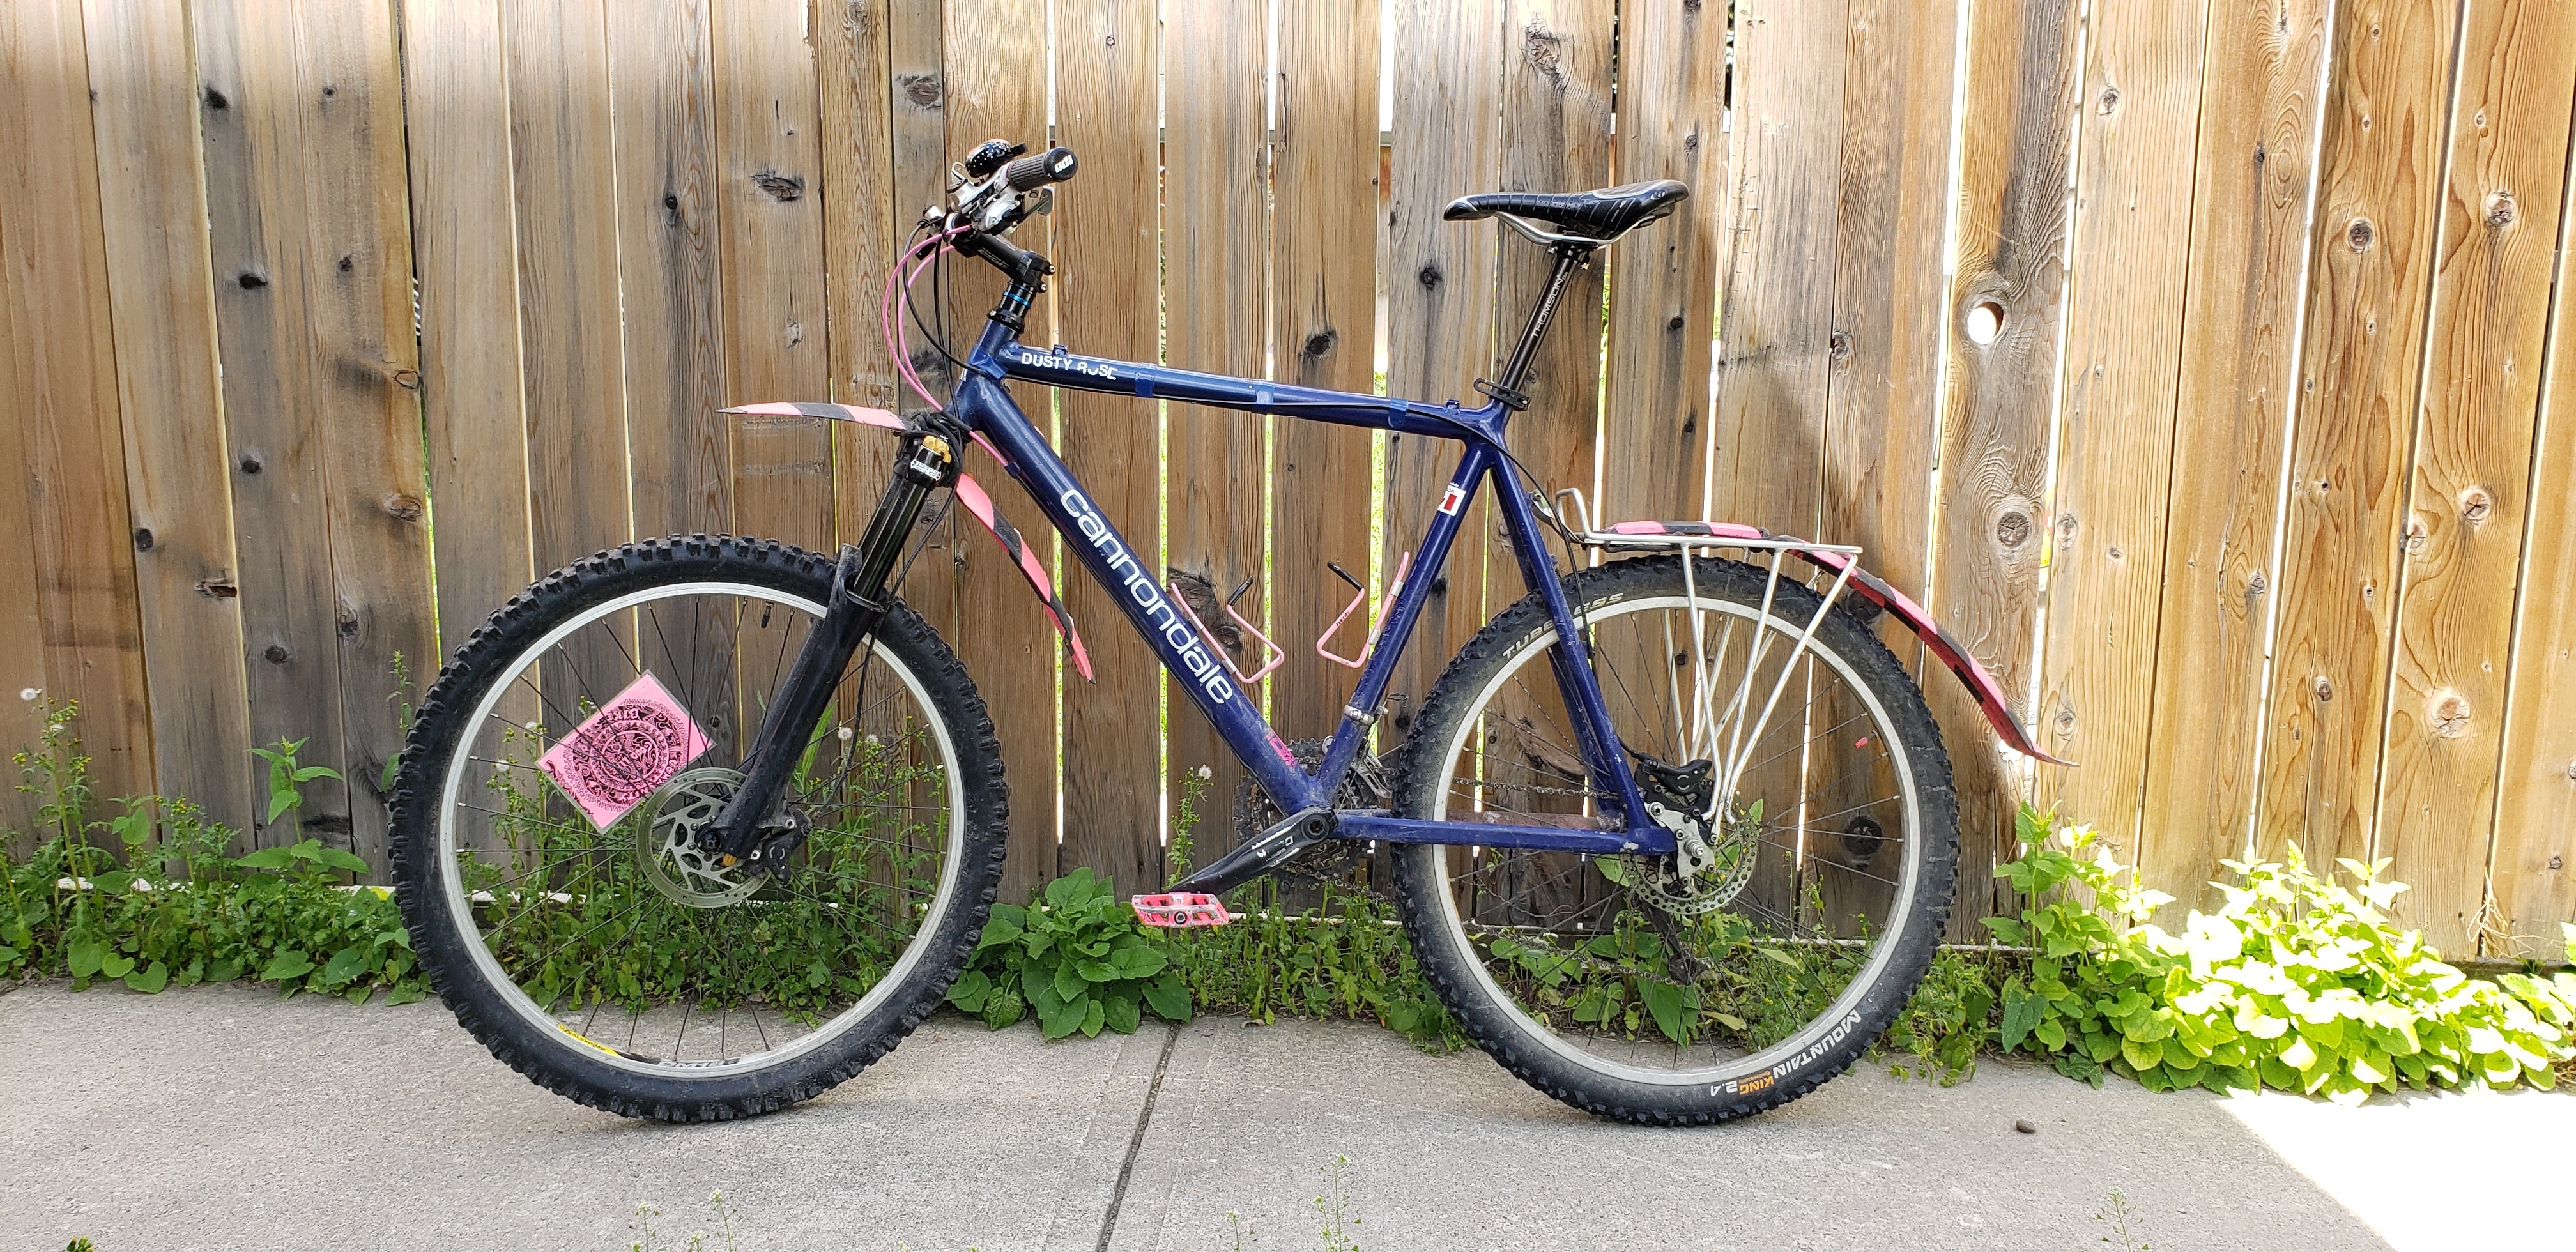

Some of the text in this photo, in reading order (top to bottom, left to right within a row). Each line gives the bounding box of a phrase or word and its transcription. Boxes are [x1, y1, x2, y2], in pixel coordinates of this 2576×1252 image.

[1531, 276, 1564, 337] THOMSON
[1021, 352, 1073, 371] DUSTY
[1061, 489, 1233, 705] cannondale
[1710, 1009, 1861, 1097] MOUNTAIN KING 2.4
